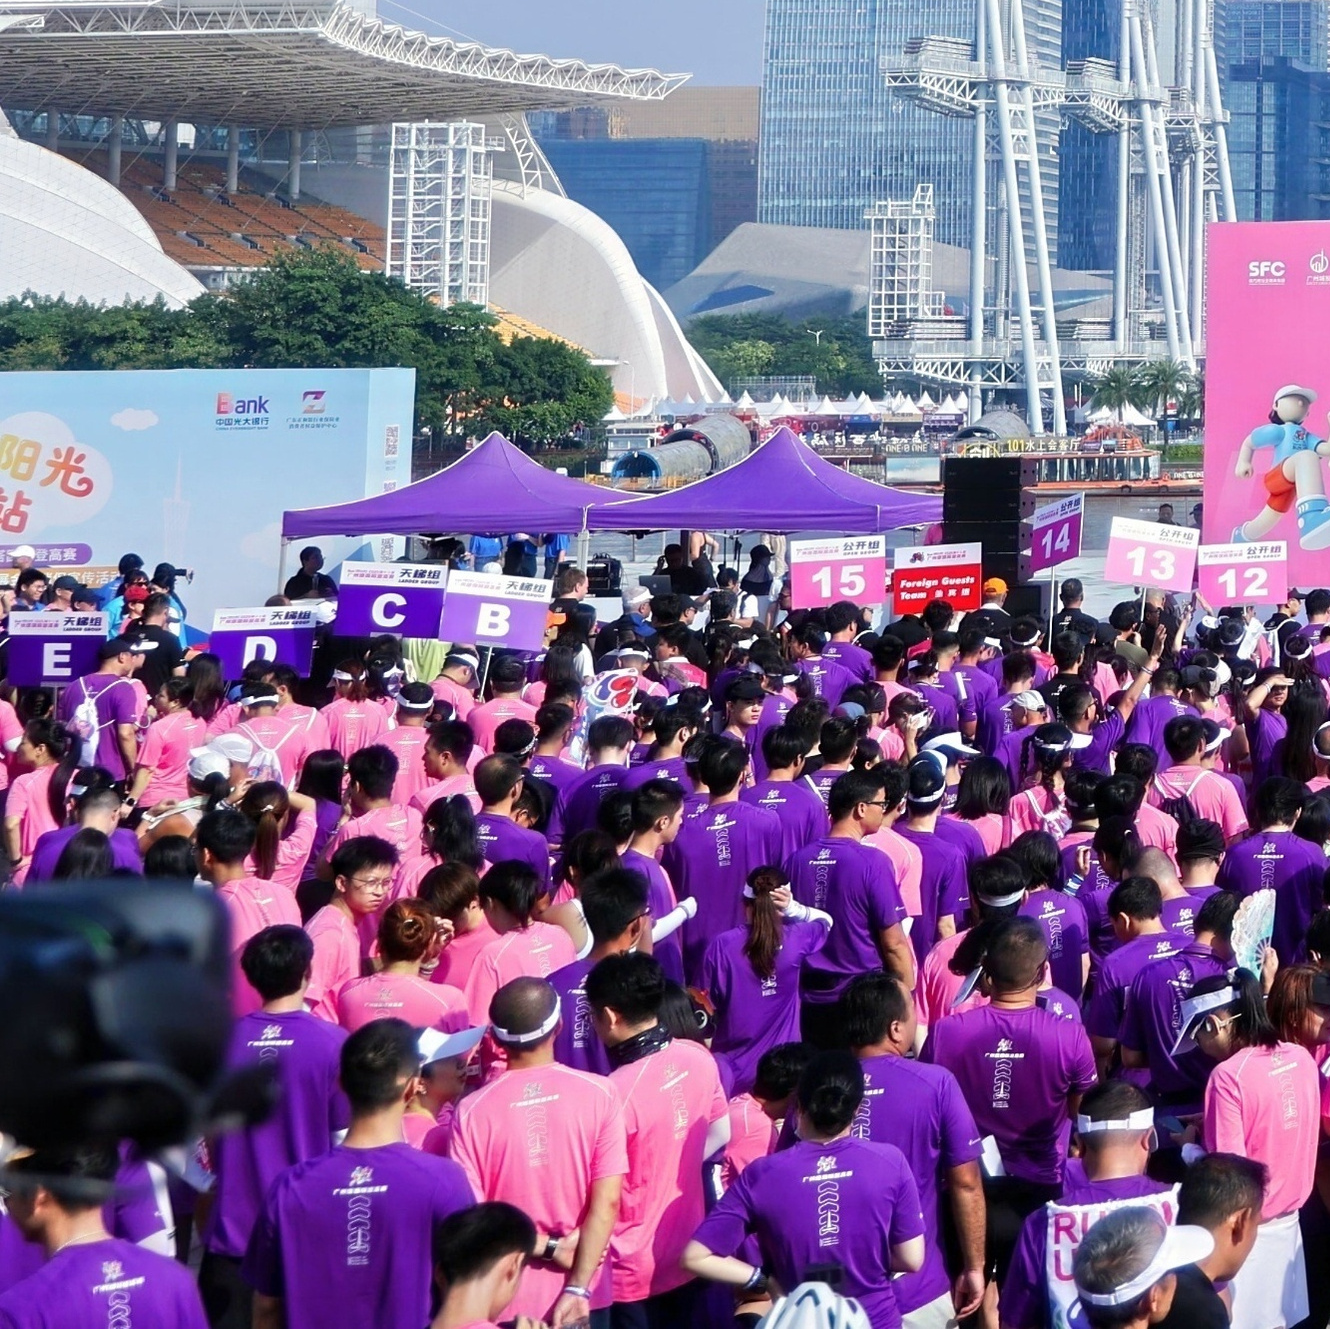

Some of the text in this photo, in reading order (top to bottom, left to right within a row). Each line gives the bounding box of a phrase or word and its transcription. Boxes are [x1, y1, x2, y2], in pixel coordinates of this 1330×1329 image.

[1248, 261, 1286, 277] SFC
[216, 392, 270, 415] Bank
[215, 416, 270, 427] 中国光大银行
[1007, 439, 1080, 452] 101水上会客厅
[843, 541, 880, 551] 公开组
[1041, 522, 1070, 559] 14
[1247, 545, 1282, 555] 公开组
[1126, 545, 1175, 581] 13
[400, 568, 441, 580] 天梯组
[812, 565, 866, 598] 15
[505, 580, 548, 594] 天梯组
[900, 575, 975, 589] Foreign Guests
[1218, 567, 1269, 598] 12
[900, 591, 926, 600] Team
[270, 610, 312, 621] 天梯组
[371, 593, 408, 628] C
[63, 616, 103, 627] 天梯组
[475, 602, 511, 637] B
[42, 642, 72, 676] E
[242, 635, 277, 669] D
